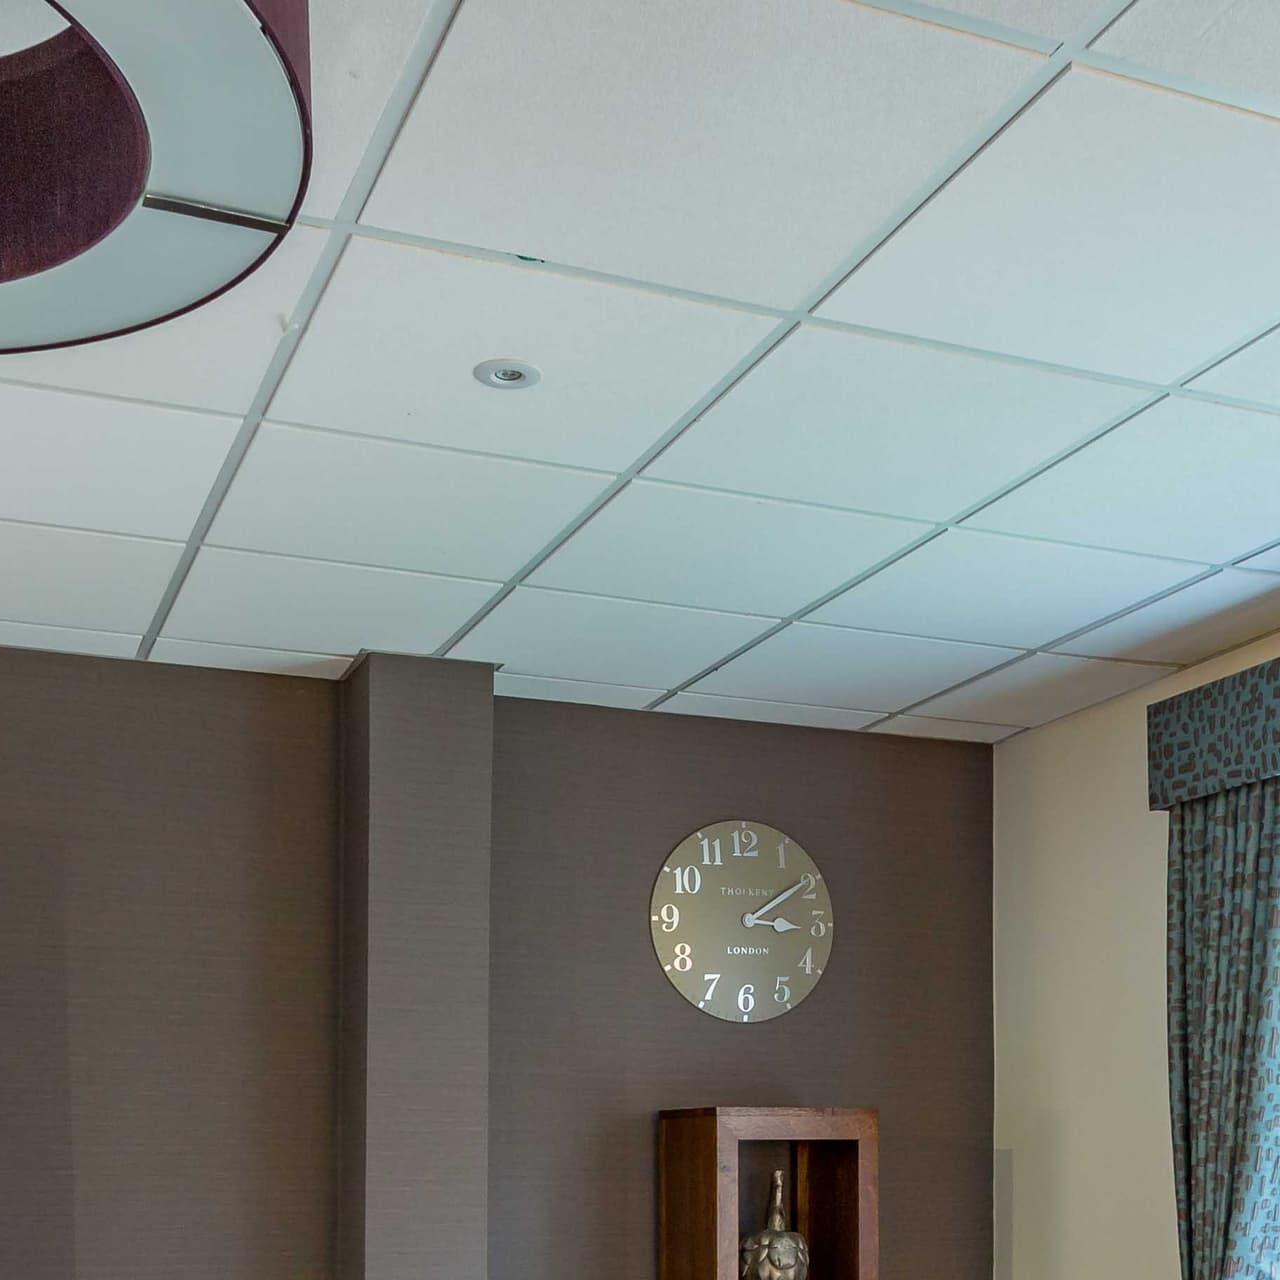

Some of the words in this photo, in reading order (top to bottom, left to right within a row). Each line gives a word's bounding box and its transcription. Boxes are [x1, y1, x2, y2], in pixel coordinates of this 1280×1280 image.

[700, 838, 723, 865] 11
[731, 830, 759, 856] 12
[776, 839, 785, 868] 1
[674, 866, 702, 894] 10
[801, 873, 817, 899] 2
[661, 904, 679, 932] 9
[811, 911, 825, 936] 3
[674, 943, 692, 971] 8
[727, 946, 769, 955] LONDON
[797, 947, 814, 974] 4
[704, 974, 720, 1000] 7
[738, 984, 755, 1012] 6
[774, 977, 791, 1002] 5
